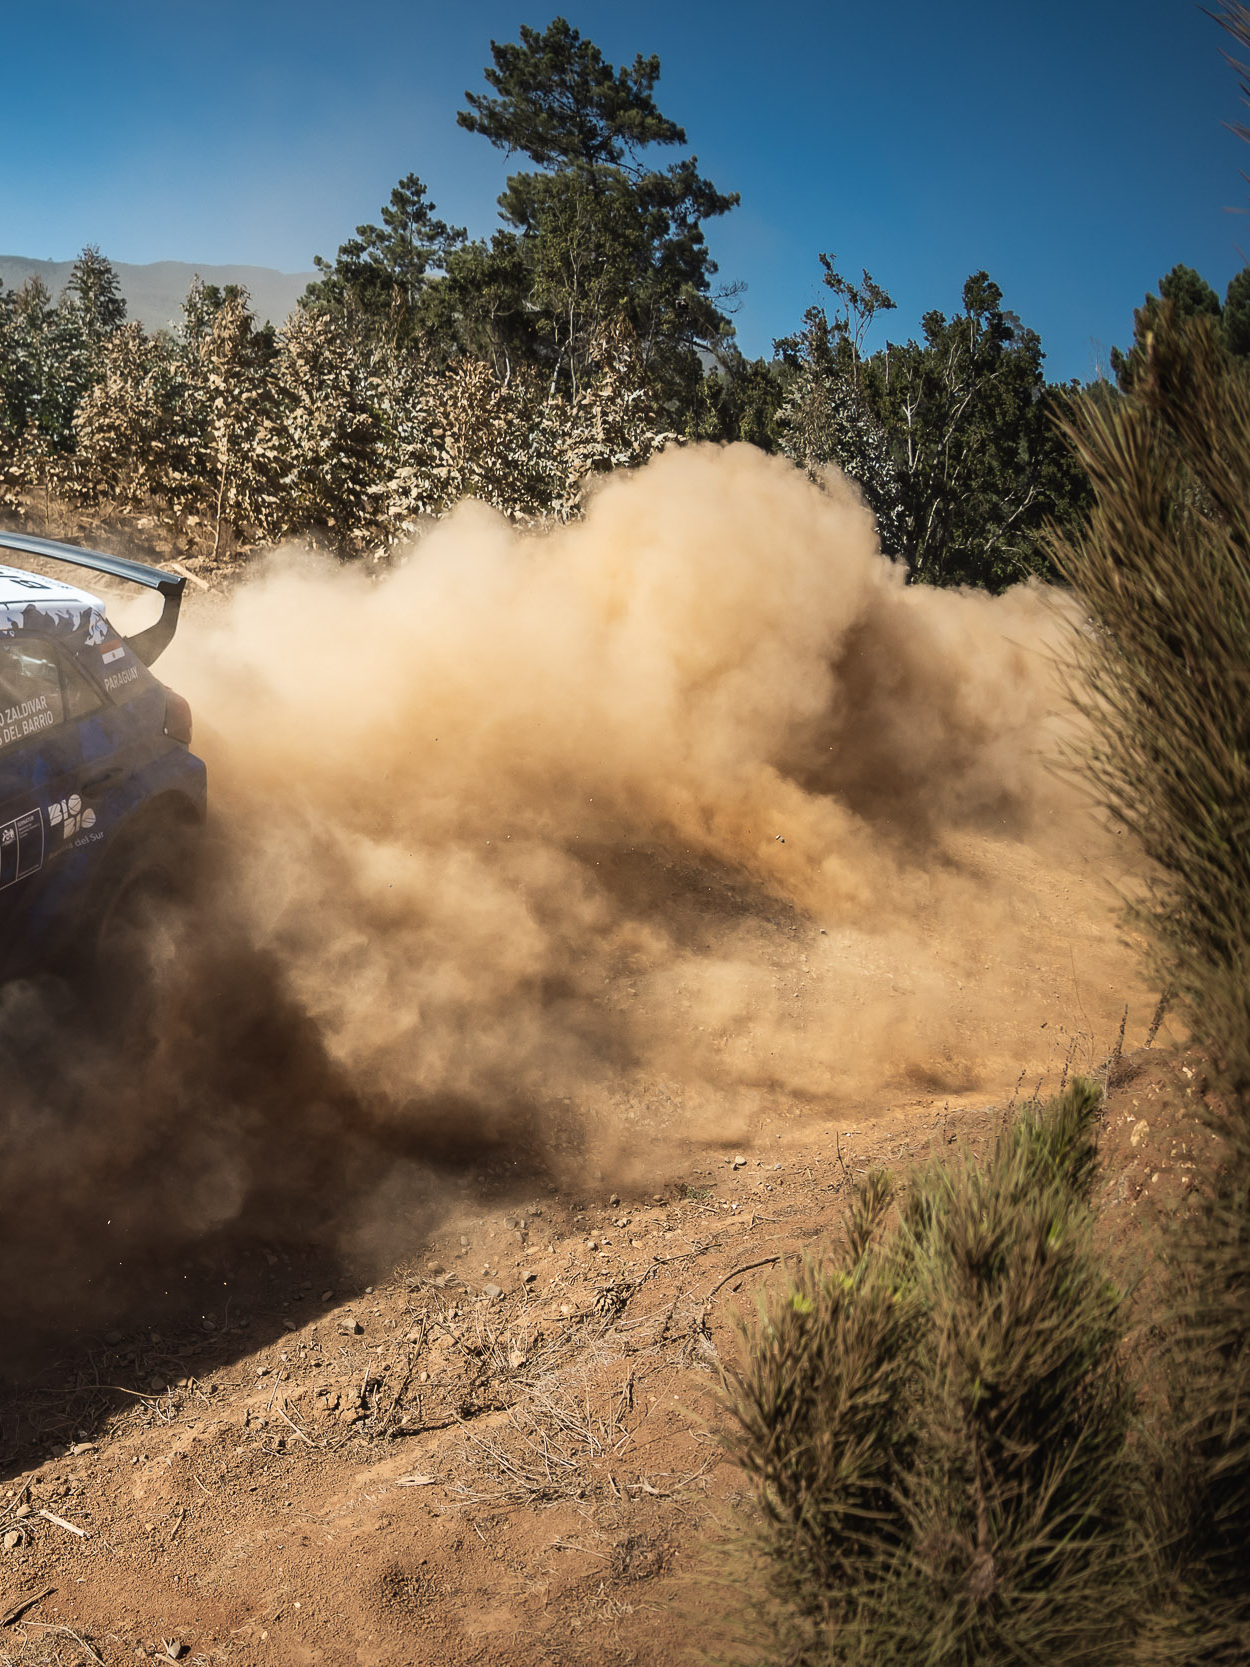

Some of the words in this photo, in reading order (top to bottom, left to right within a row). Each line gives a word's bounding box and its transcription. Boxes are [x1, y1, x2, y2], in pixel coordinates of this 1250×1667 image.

[103, 666, 139, 692] PARAGUAY
[4, 695, 48, 724] ZALDIVAR
[3, 724, 22, 743] DEL
[21, 710, 54, 735] BARRIO
[74, 835, 90, 847] del
[89, 831, 105, 842] Sur
